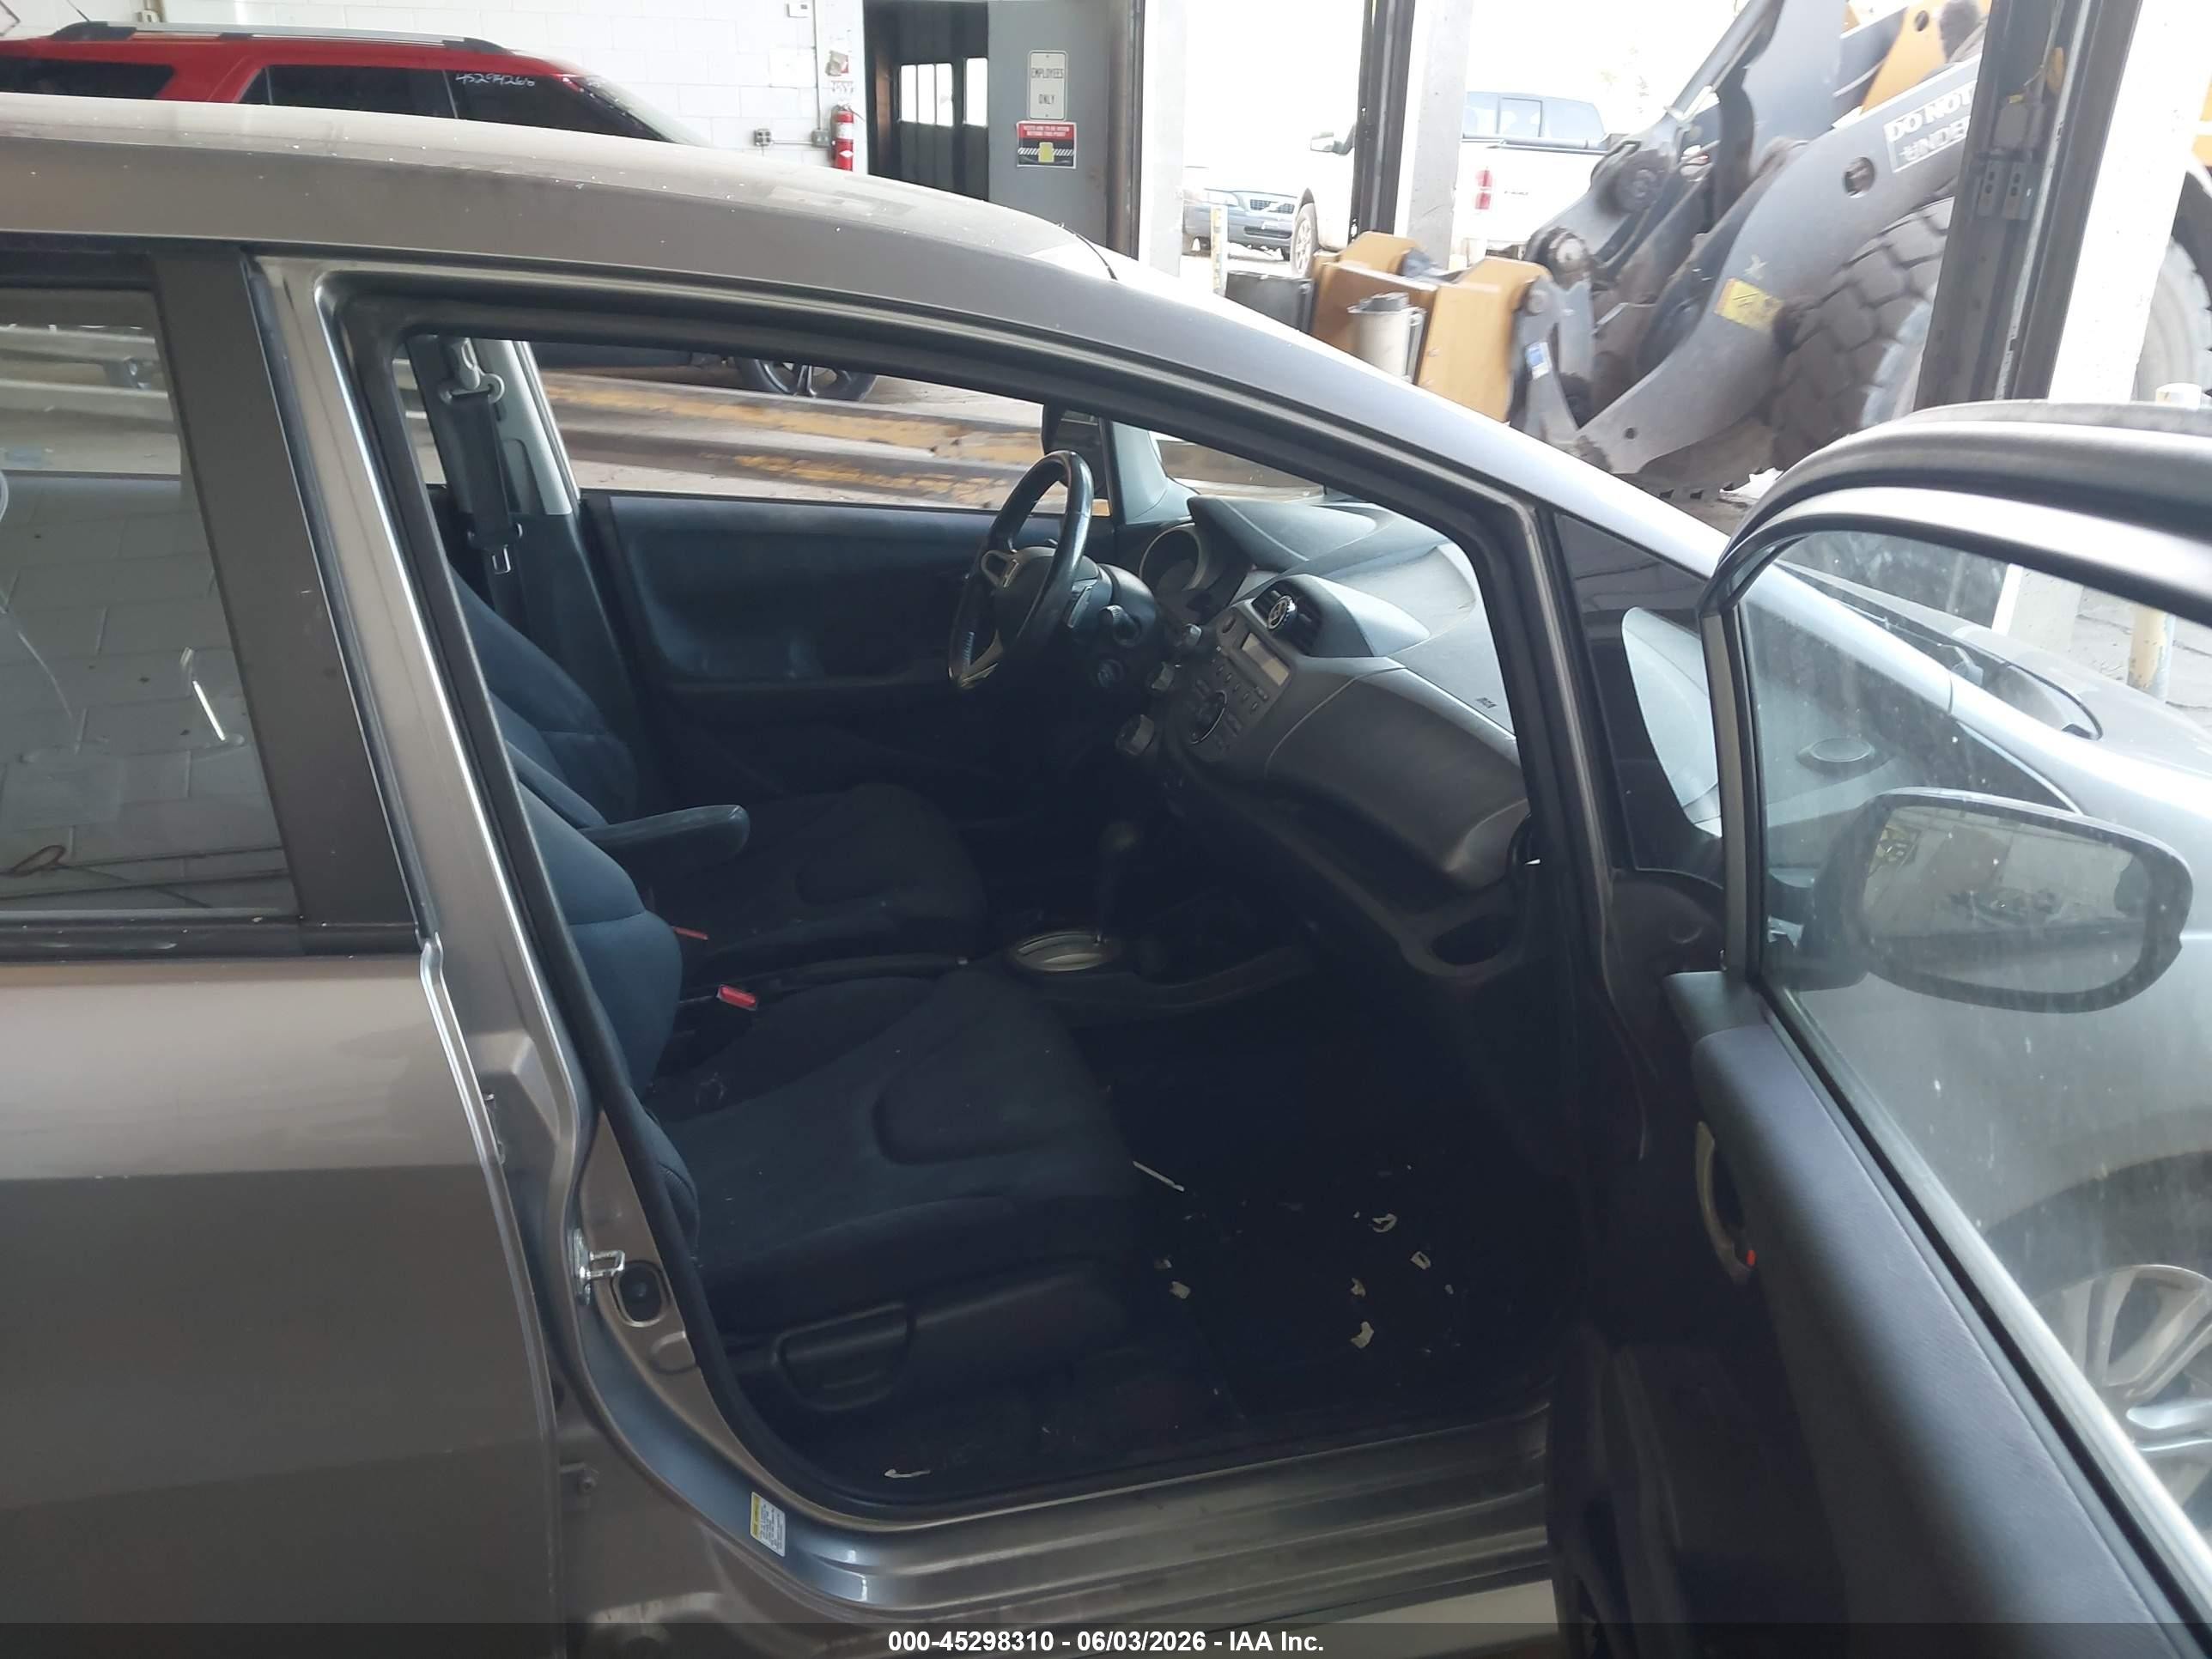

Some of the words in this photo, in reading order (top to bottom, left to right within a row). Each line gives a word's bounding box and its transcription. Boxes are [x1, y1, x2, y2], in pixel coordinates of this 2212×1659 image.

[1030, 68, 1064, 78] EMPLOYEES
[1038, 94, 1055, 104] ONLY
[1883, 112, 1923, 142] DO
